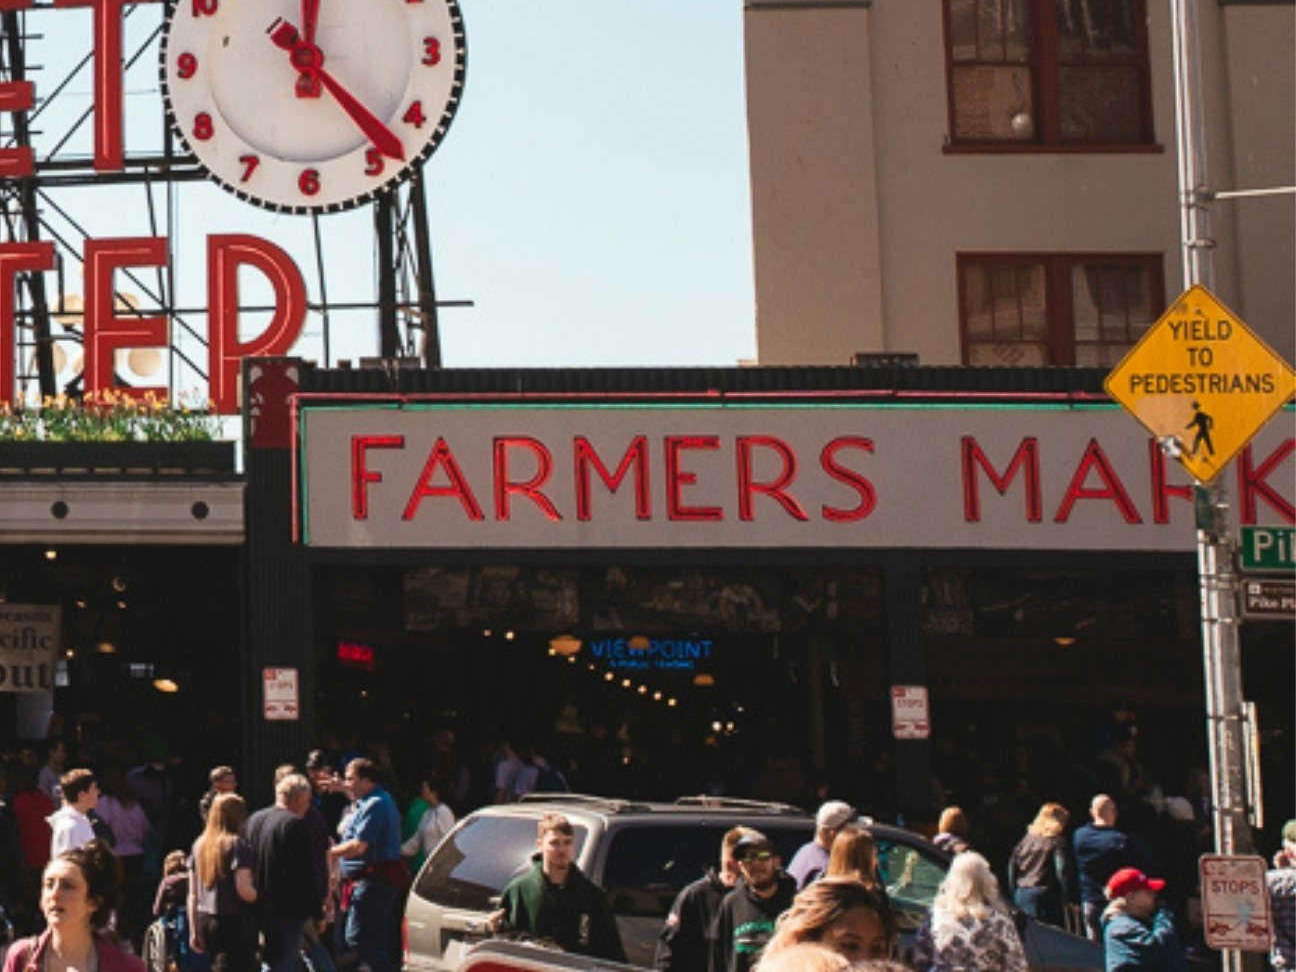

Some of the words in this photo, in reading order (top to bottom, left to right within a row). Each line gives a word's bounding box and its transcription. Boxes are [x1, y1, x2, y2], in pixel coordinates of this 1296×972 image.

[422, 37, 441, 66] 3
[177, 52, 198, 79] 9
[193, 112, 214, 141] 8
[403, 100, 426, 129] 4
[239, 155, 260, 182] 7
[365, 147, 385, 176] 5
[298, 169, 320, 196] 6
[1167, 320, 1233, 342] YIELD
[1187, 347, 1214, 368] TO
[1129, 373, 1275, 395] PEDESTRIANS
[351, 435, 878, 522] FARMERS
[1212, 879, 1260, 895] STOPS
